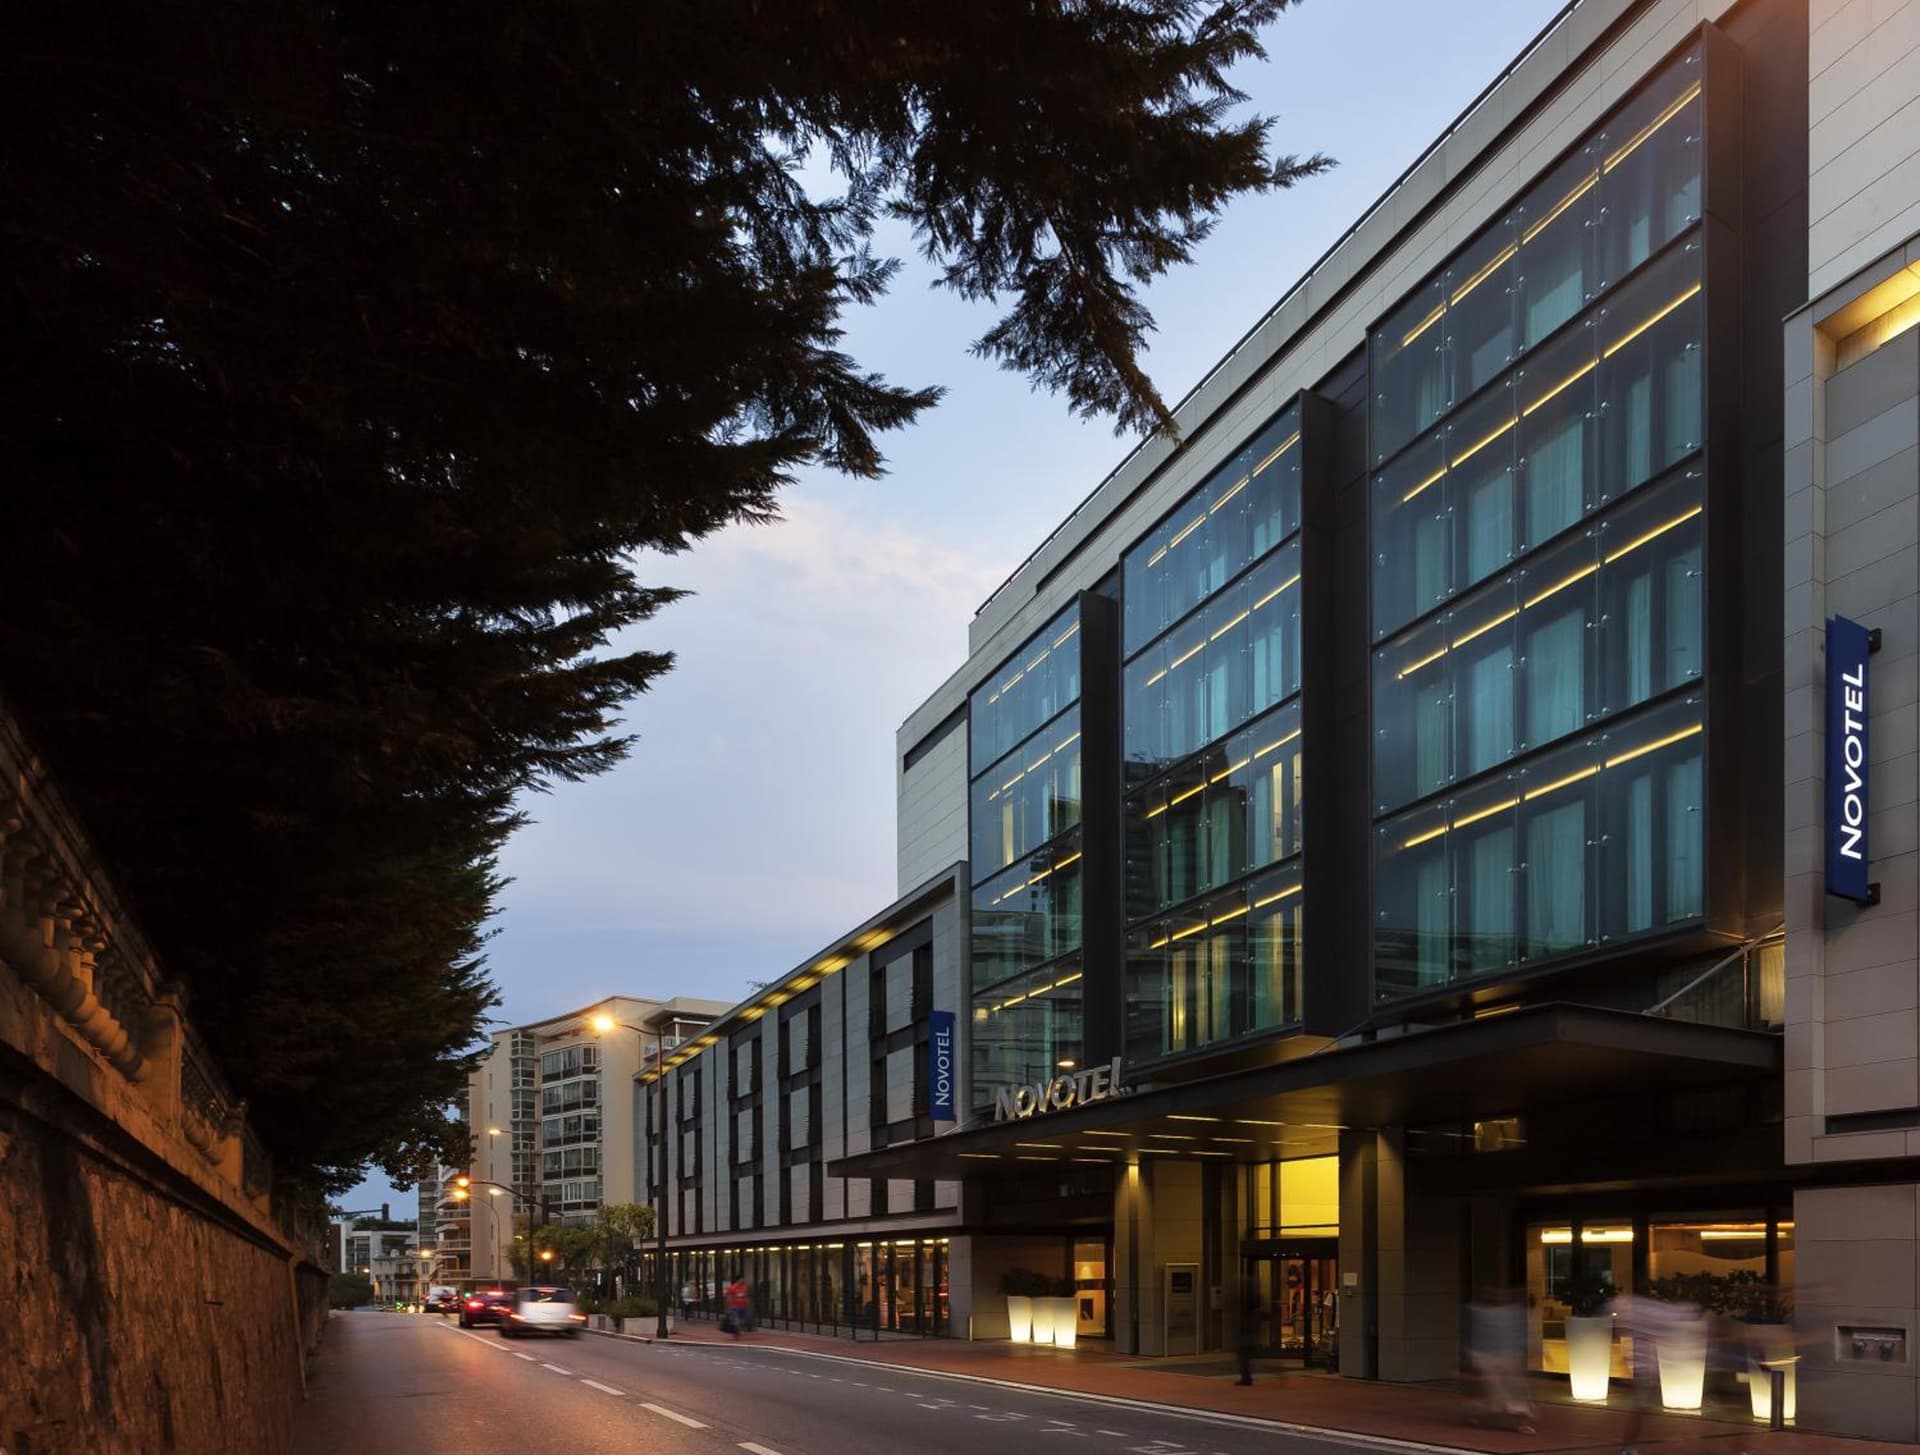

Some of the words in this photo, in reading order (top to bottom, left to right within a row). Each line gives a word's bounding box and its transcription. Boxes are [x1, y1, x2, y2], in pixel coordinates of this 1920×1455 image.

[1840, 664, 1862, 860] NOVOTEL
[936, 1027, 949, 1105] NOVOTEL
[995, 1057, 1121, 1120] NOVOTEL
